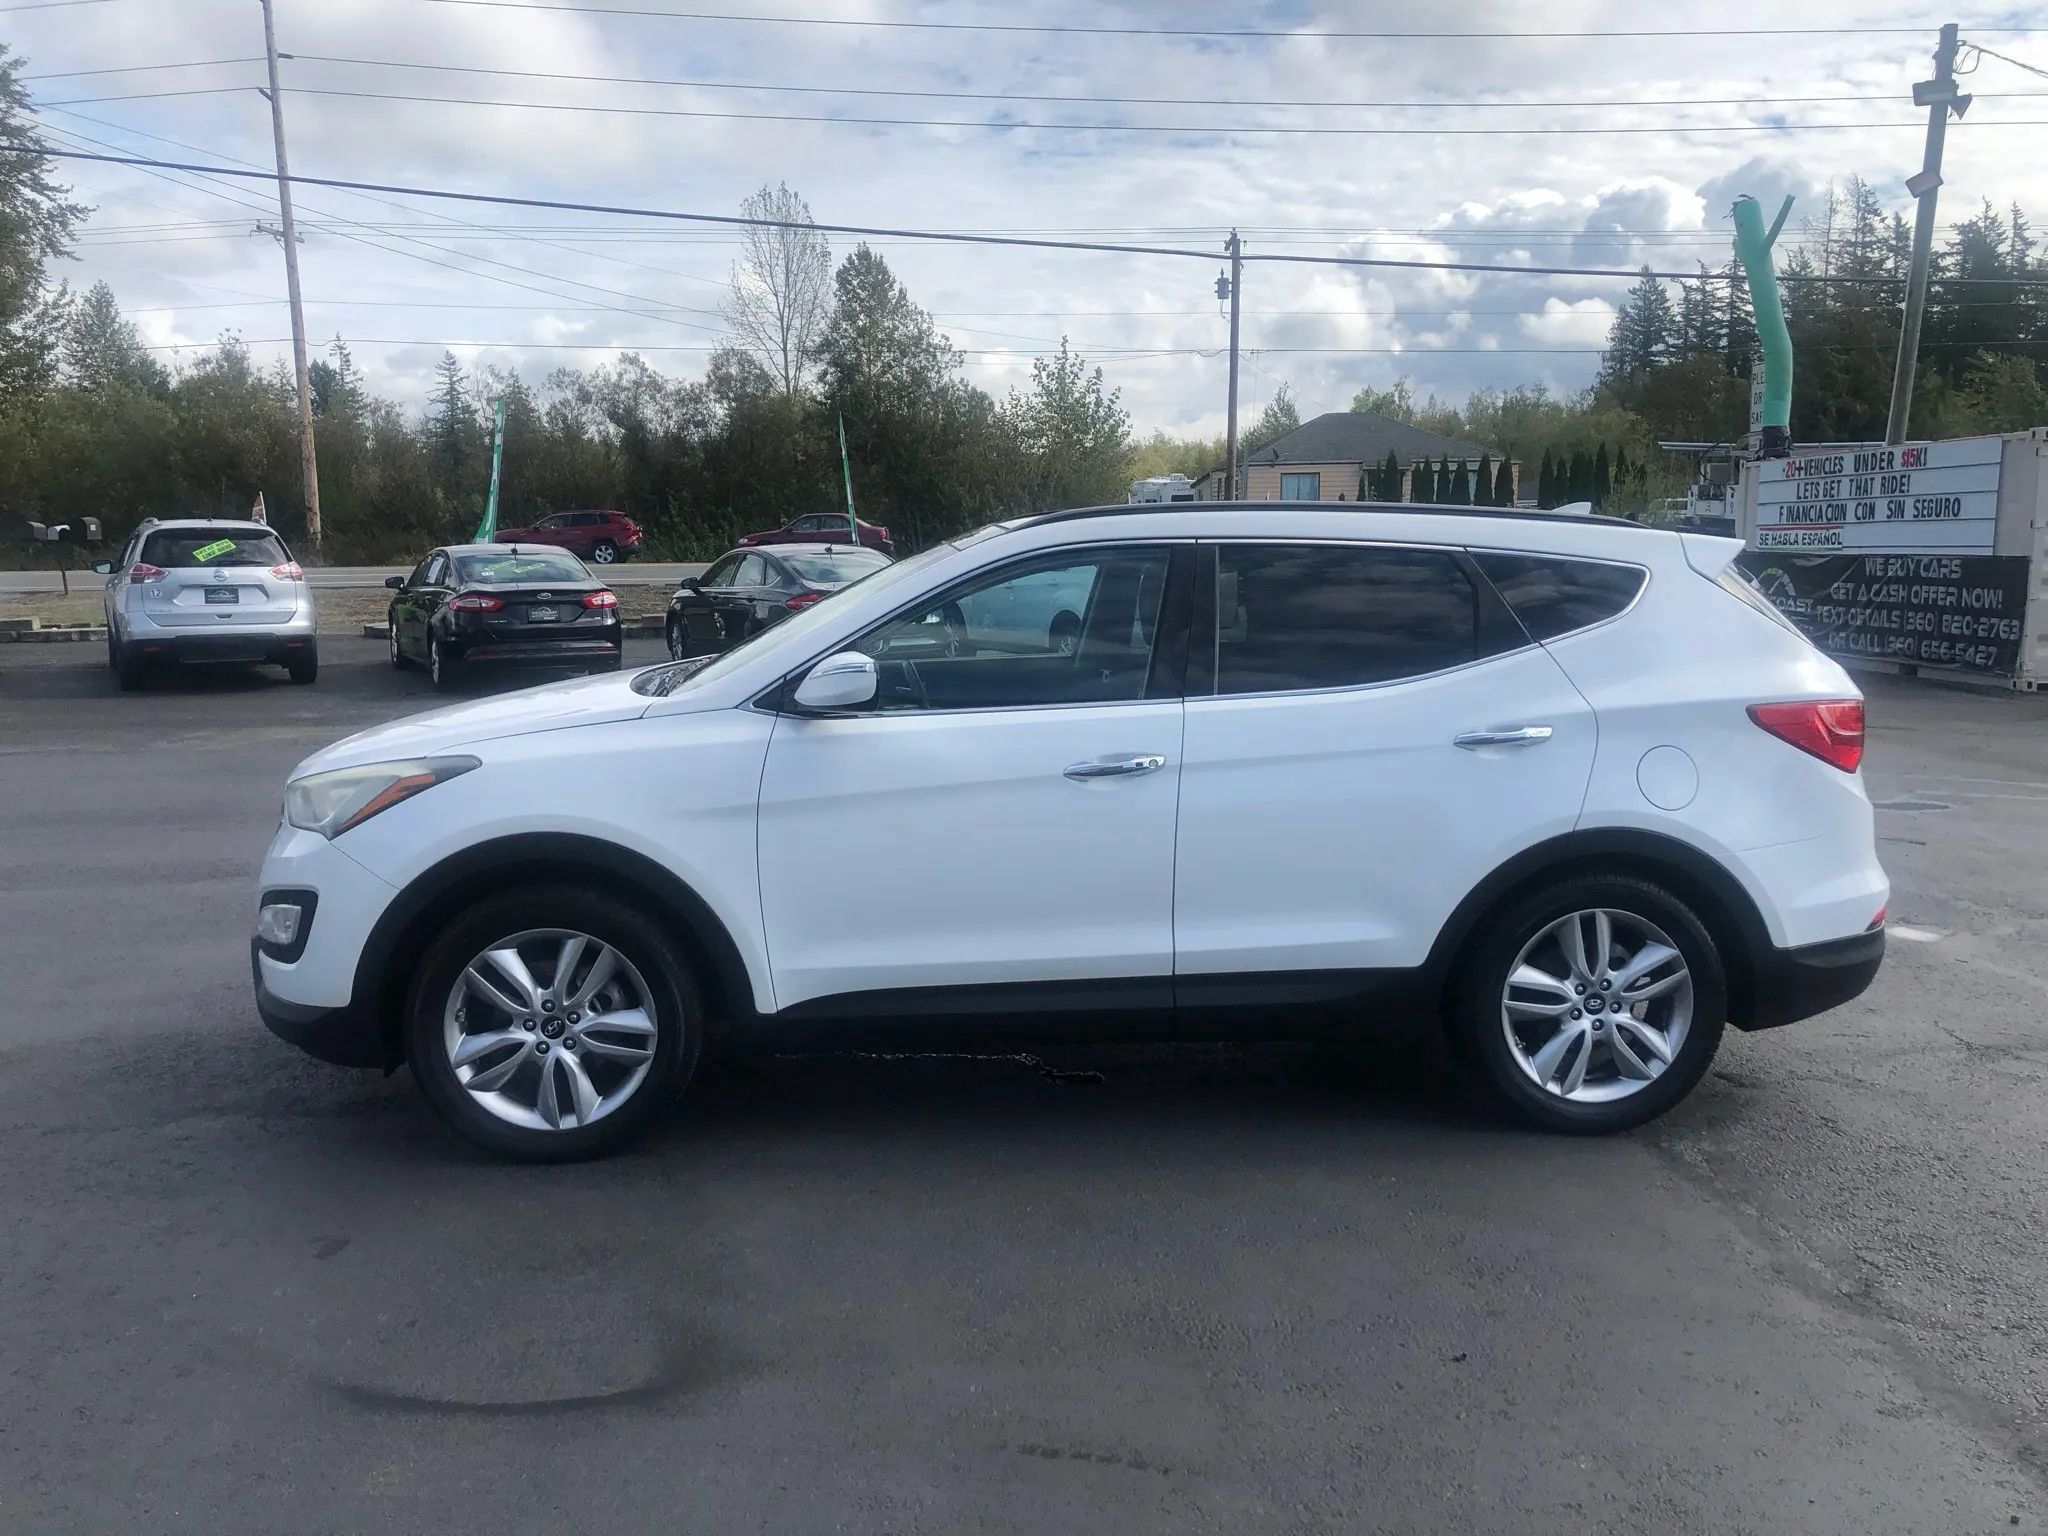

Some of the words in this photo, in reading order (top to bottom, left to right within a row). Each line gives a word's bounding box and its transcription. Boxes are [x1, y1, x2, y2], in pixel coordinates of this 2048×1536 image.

[1752, 372, 1765, 385] PLE
[1853, 450, 1895, 473] UNDER
[1796, 482, 1820, 500] LETS
[1823, 480, 1842, 498] GET
[1848, 477, 1875, 497] THAT
[1880, 474, 1911, 495] RIDE!
[1854, 501, 1875, 521] CON
[1886, 499, 1906, 519] SIN
[1912, 496, 1961, 519] SEGURO
[1759, 533, 1770, 546] SE
[1770, 533, 1800, 546] HABLA
[1801, 529, 1843, 546] ESPAÑOL
[1865, 557, 1886, 577] WE
[1886, 558, 1918, 578] BUY
[1919, 558, 1962, 579] CARS
[1830, 582, 1855, 600] GET
[1857, 583, 1868, 601] A
[1870, 584, 1908, 604] CASH
[1911, 585, 1959, 607] OFFER
[1961, 587, 2003, 610] NOW!
[1849, 632, 1881, 653] CALL
